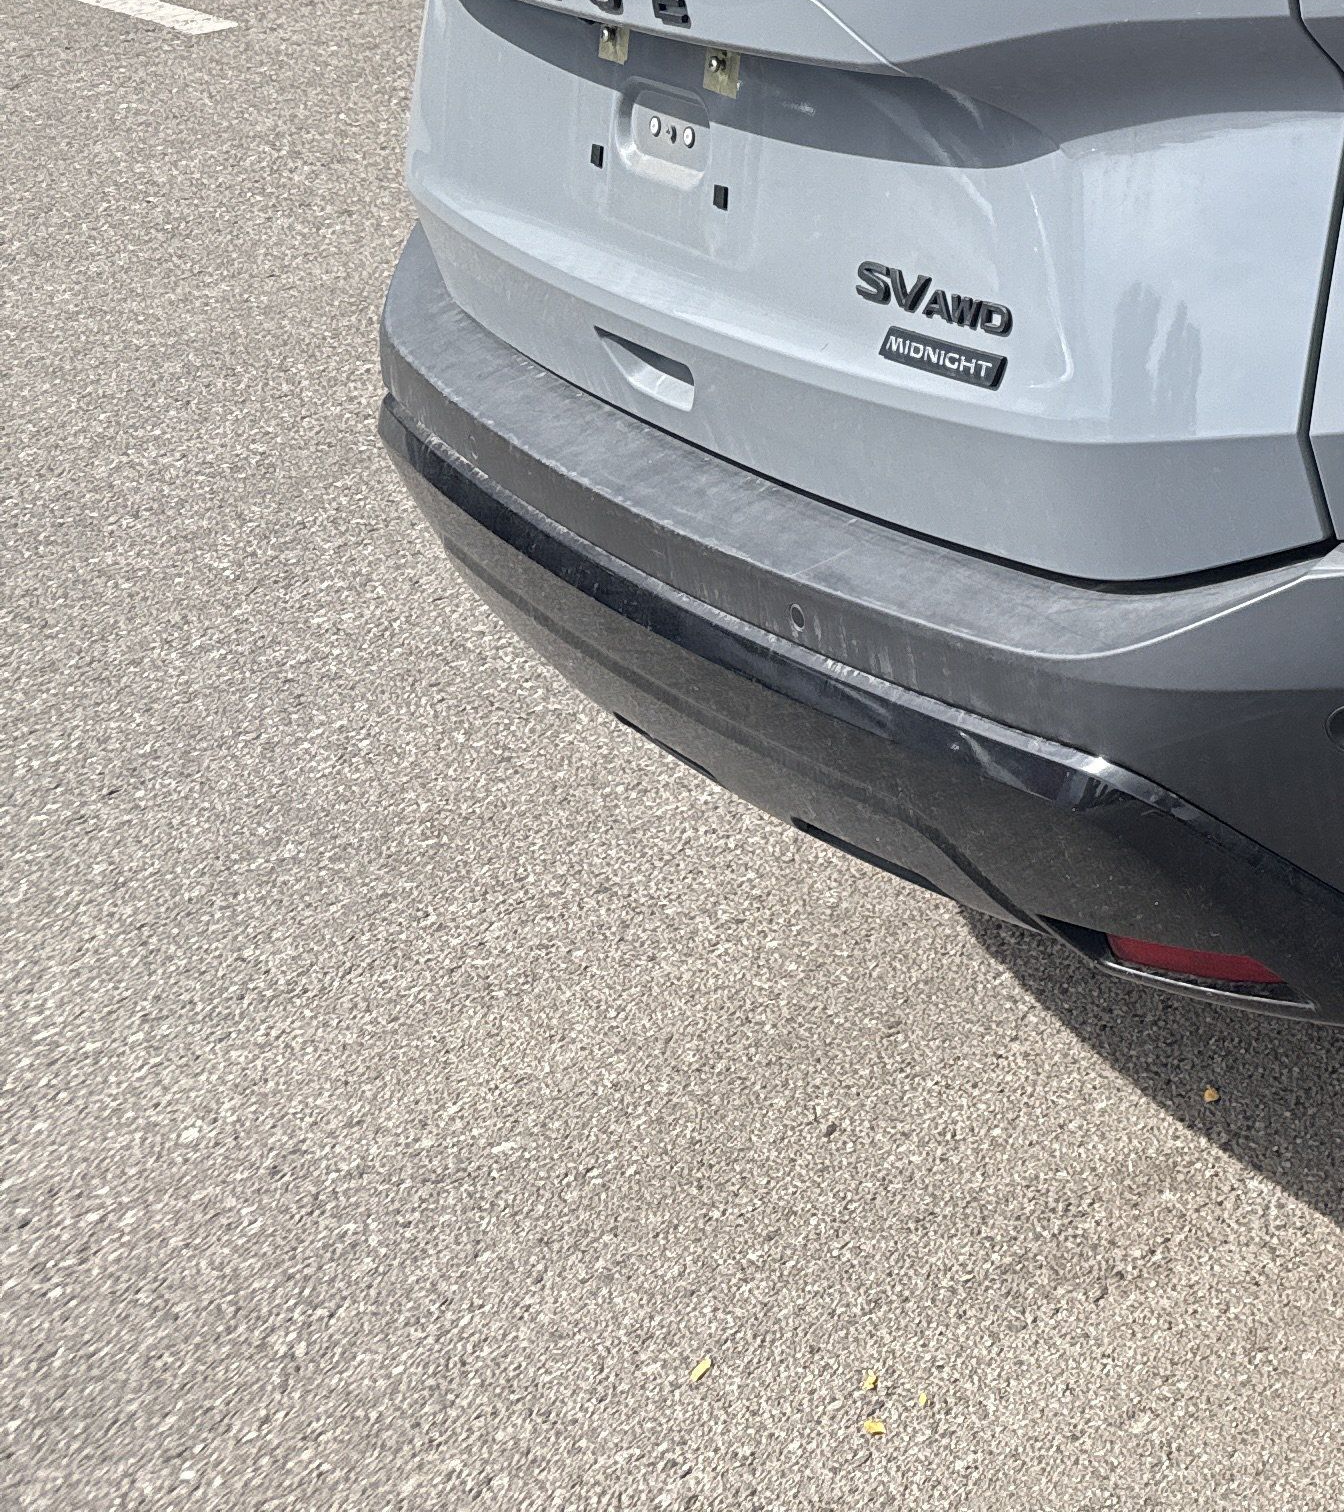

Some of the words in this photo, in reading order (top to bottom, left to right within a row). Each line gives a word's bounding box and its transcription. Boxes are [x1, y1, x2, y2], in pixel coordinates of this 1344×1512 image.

[855, 260, 933, 314] SV
[922, 289, 1013, 338] AWD
[885, 335, 993, 378] MIDNIGHT
